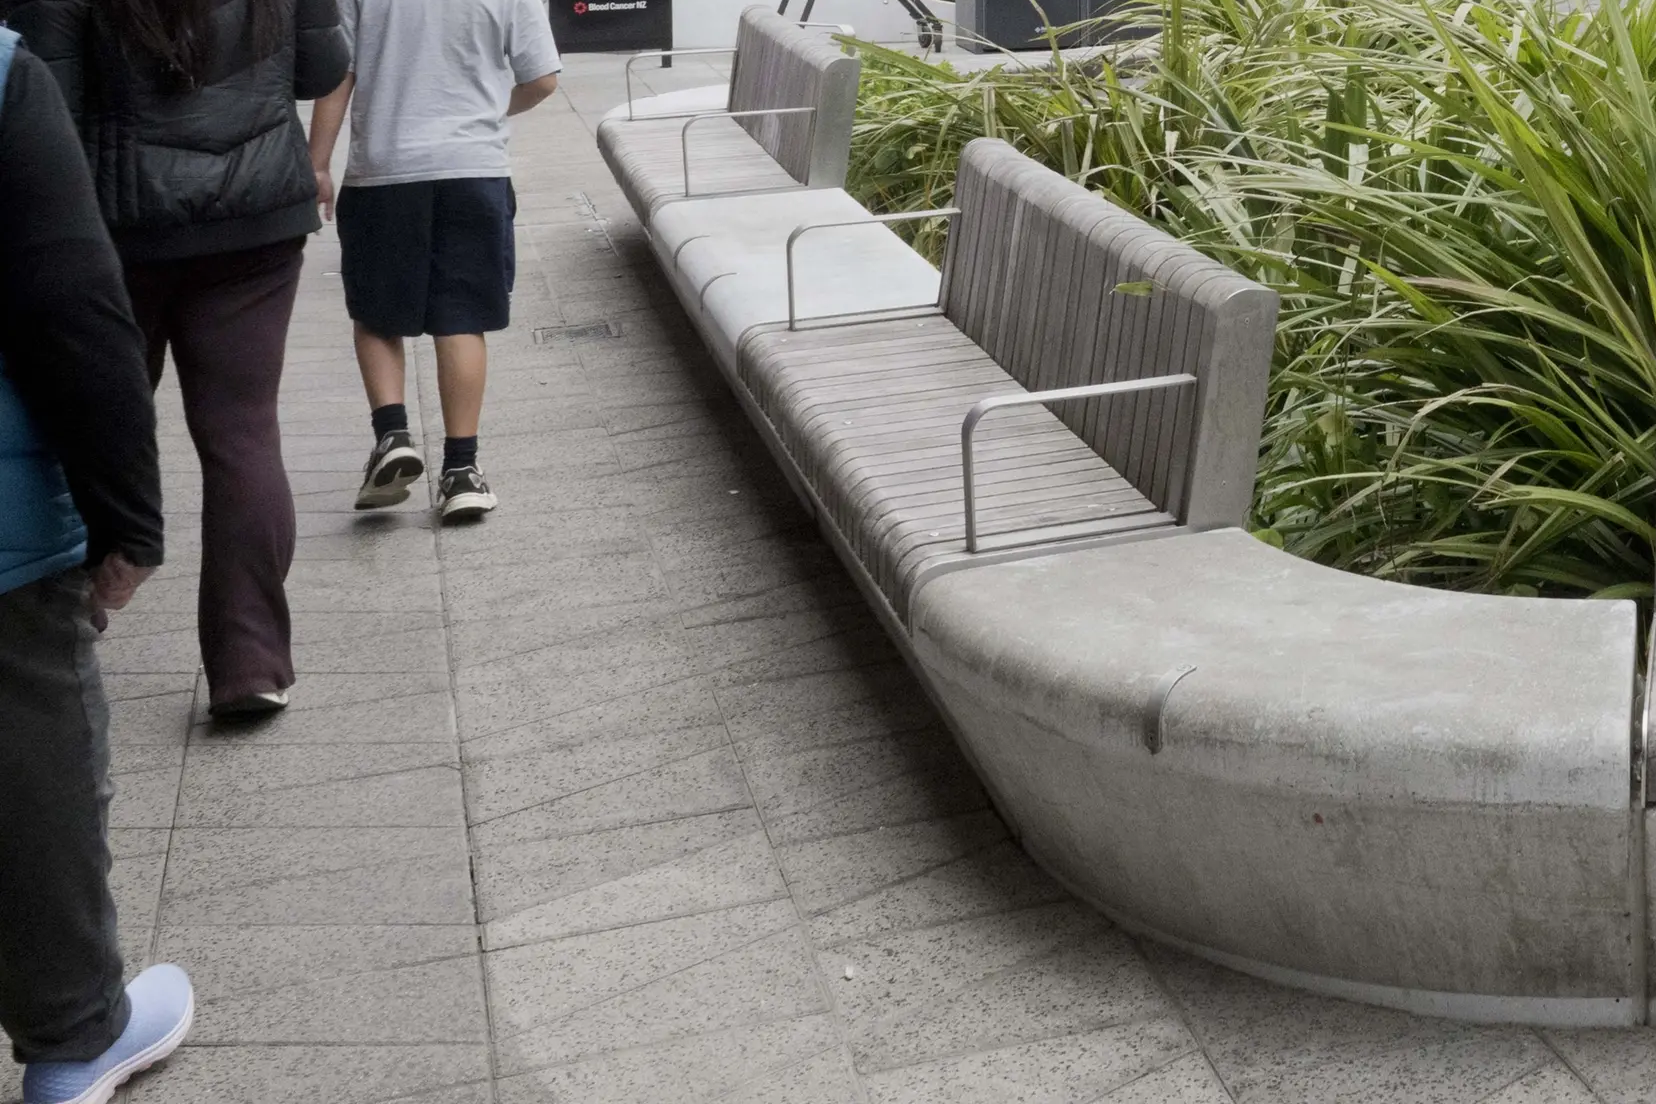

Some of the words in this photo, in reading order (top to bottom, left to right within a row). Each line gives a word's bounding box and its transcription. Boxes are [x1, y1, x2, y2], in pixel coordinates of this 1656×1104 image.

[588, 3, 609, 11] Blood
[610, 1, 635, 10] Cancer
[636, 0, 648, 9] NZ
